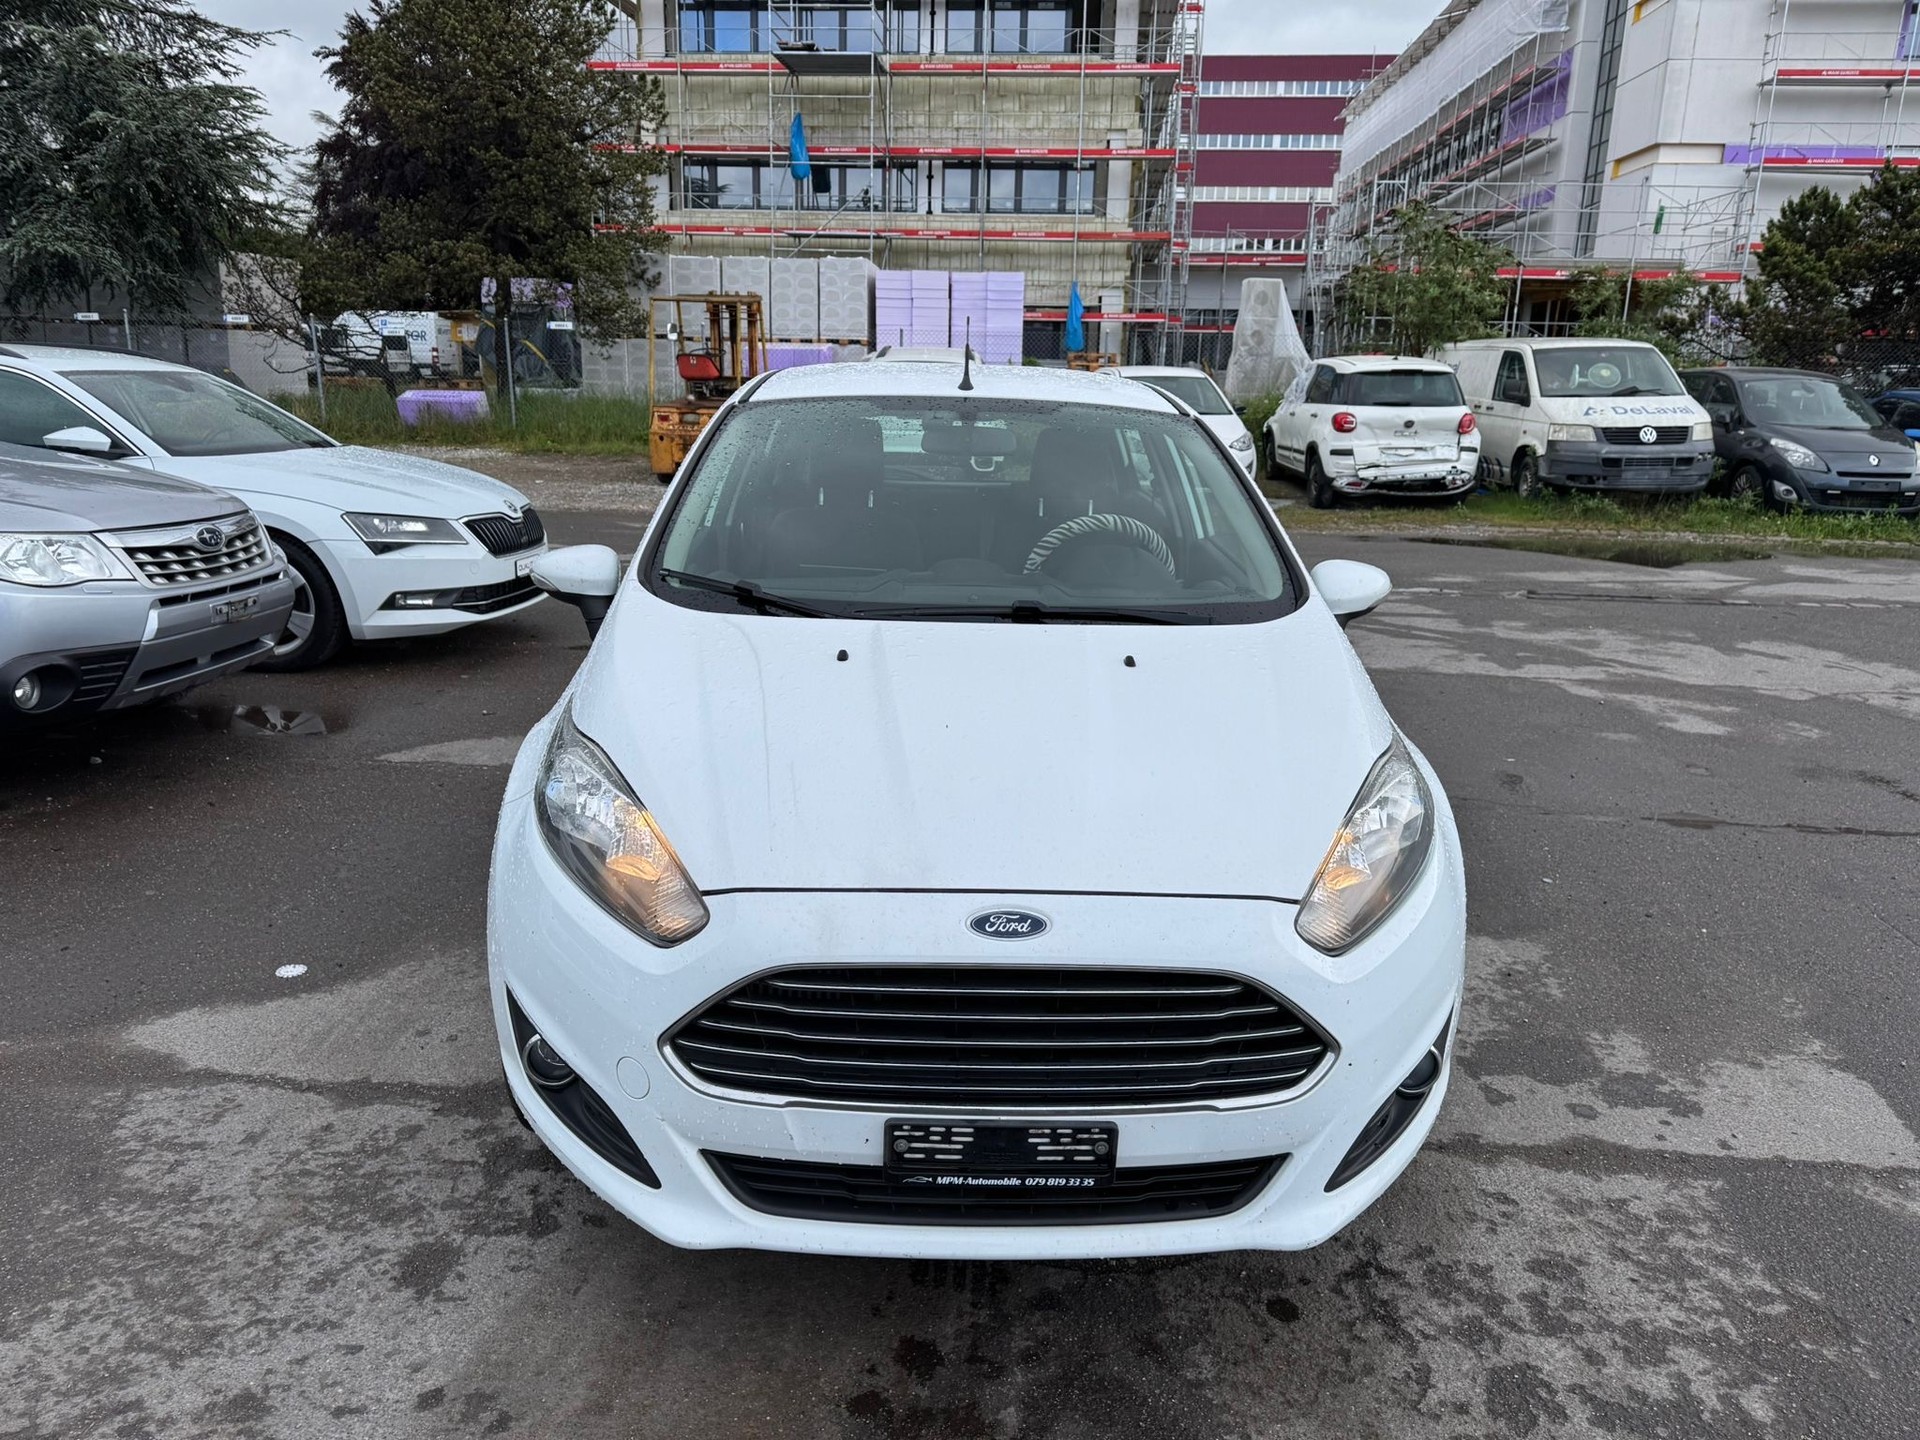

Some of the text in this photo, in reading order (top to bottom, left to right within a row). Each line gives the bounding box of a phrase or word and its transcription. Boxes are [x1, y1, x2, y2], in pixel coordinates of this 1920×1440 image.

[1611, 405, 1696, 416] DeLaval
[985, 914, 1031, 932] Ford
[935, 1176, 1096, 1187] MPM-Automobile 079 819 33 35
